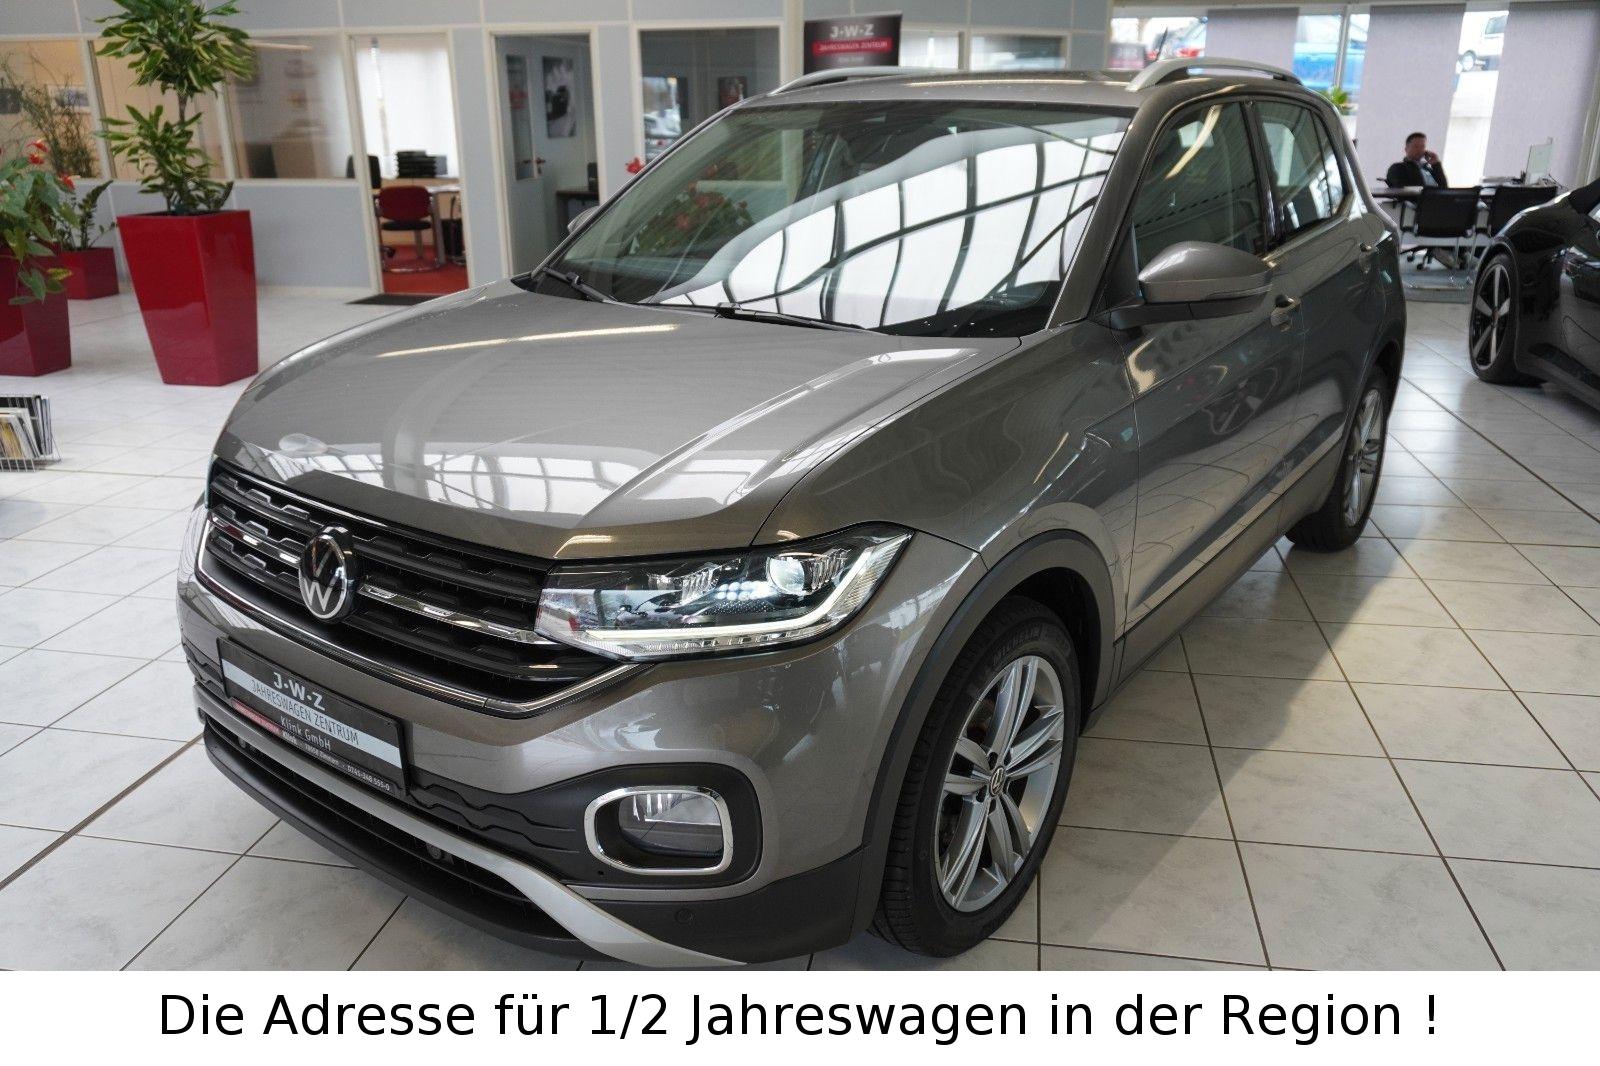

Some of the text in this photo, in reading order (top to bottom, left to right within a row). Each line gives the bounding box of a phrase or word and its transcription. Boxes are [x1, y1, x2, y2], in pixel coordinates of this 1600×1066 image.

[252, 679, 312, 722] JAHRESWAGEN
[314, 713, 360, 746] ZENTRUM
[304, 729, 331, 752] GmbH
